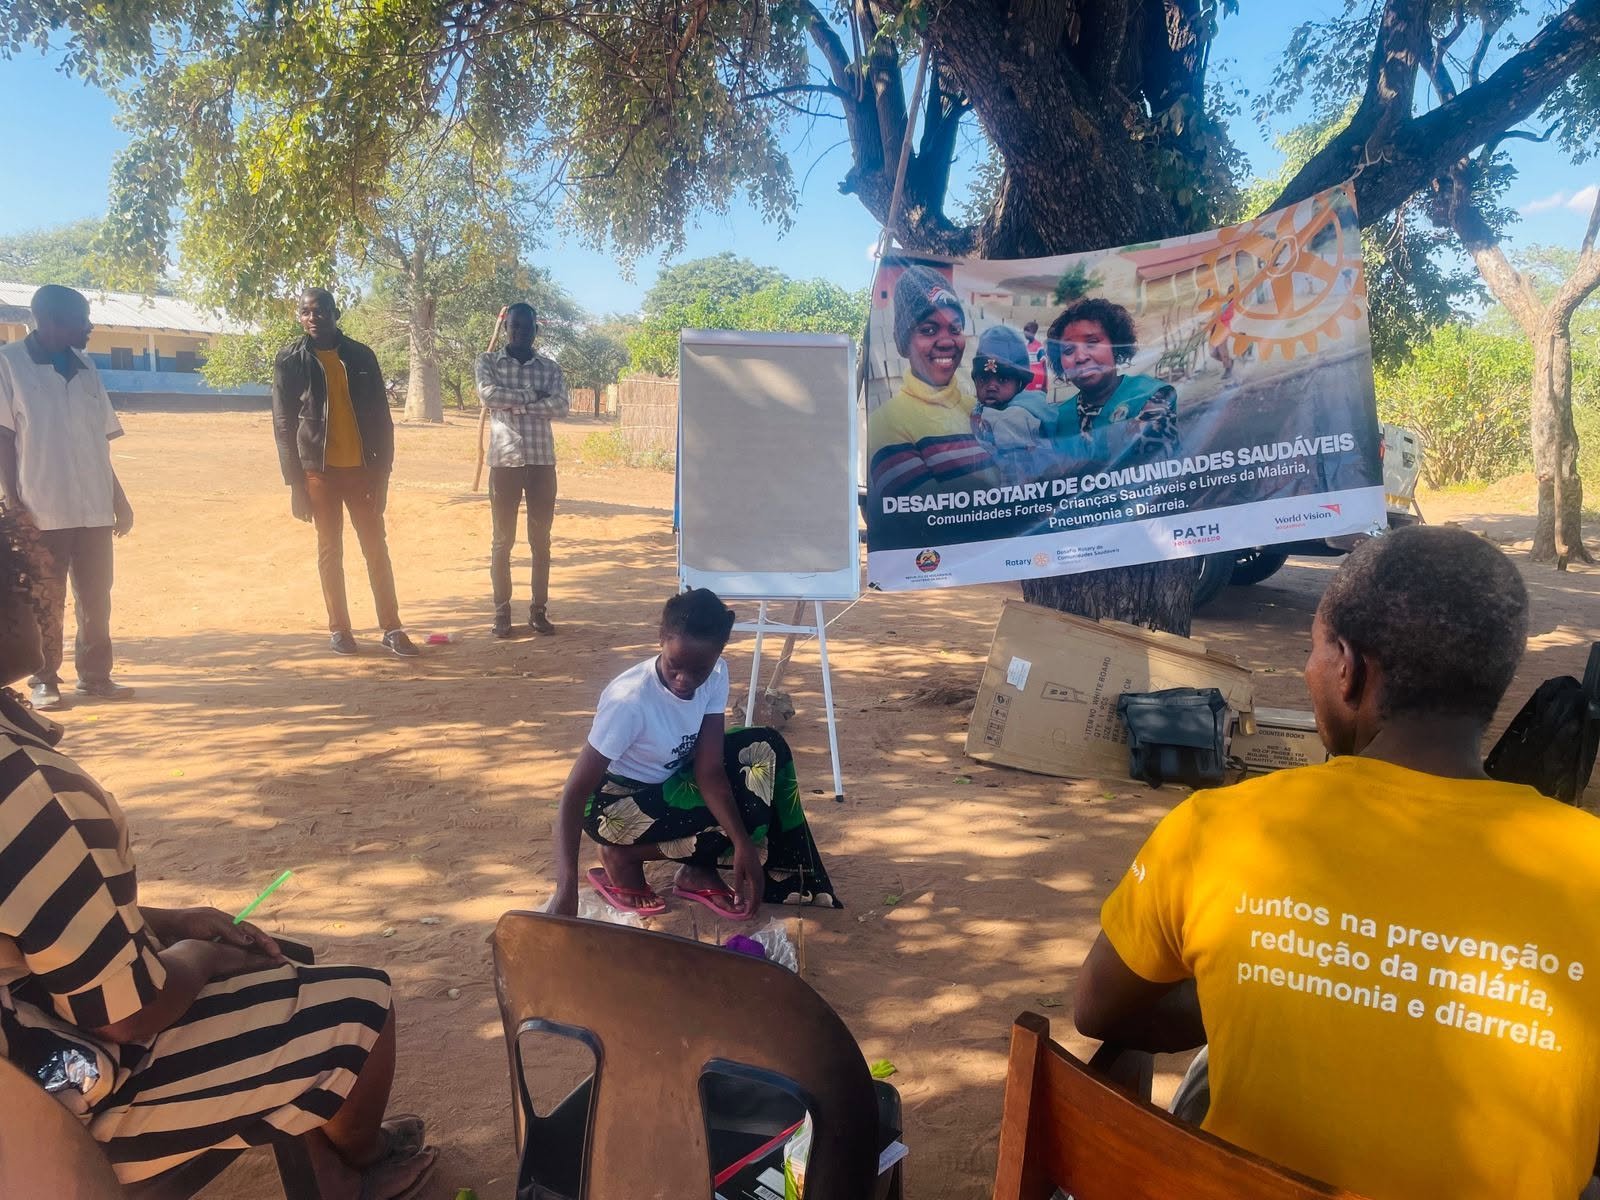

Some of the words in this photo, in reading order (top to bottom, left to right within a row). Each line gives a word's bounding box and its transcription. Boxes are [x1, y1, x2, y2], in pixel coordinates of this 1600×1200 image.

[882, 492, 970, 514] DESAFIO
[973, 481, 1049, 507] ROTARY
[1052, 477, 1078, 497] DE
[1081, 450, 1234, 492] COMUNIDADES
[1237, 433, 1355, 466] SAUDÁVEIS
[927, 507, 1012, 527] Comunidades
[1014, 502, 1057, 517] Fortes,
[1059, 492, 1117, 510] Crianças
[1120, 480, 1187, 501] Saudáveis
[1189, 480, 1197, 490] e
[1200, 474, 1237, 489] Livres
[1239, 470, 1255, 482] da
[1258, 461, 1310, 479] Malária,
[1049, 508, 1122, 528] Pneumonia
[1125, 508, 1134, 516] e
[1136, 498, 1189, 516] Diarreia.
[1173, 523, 1220, 541] PATH
[1274, 513, 1301, 525] World
[1302, 510, 1332, 521] Vision
[1005, 558, 1032, 567] Rotary
[1258, 729, 1285, 737] COUNTER
[1235, 892, 1330, 926] Juntos
[1340, 912, 1377, 938] na
[1387, 923, 1560, 974] prevenção
[1567, 961, 1585, 982] e
[1250, 929, 1370, 971] redução
[1380, 953, 1419, 982] da
[1428, 966, 1554, 1017] malária,
[1237, 961, 1398, 1013] pneumonia
[1407, 998, 1425, 1018] e
[1434, 1001, 1562, 1052] diarreia.
